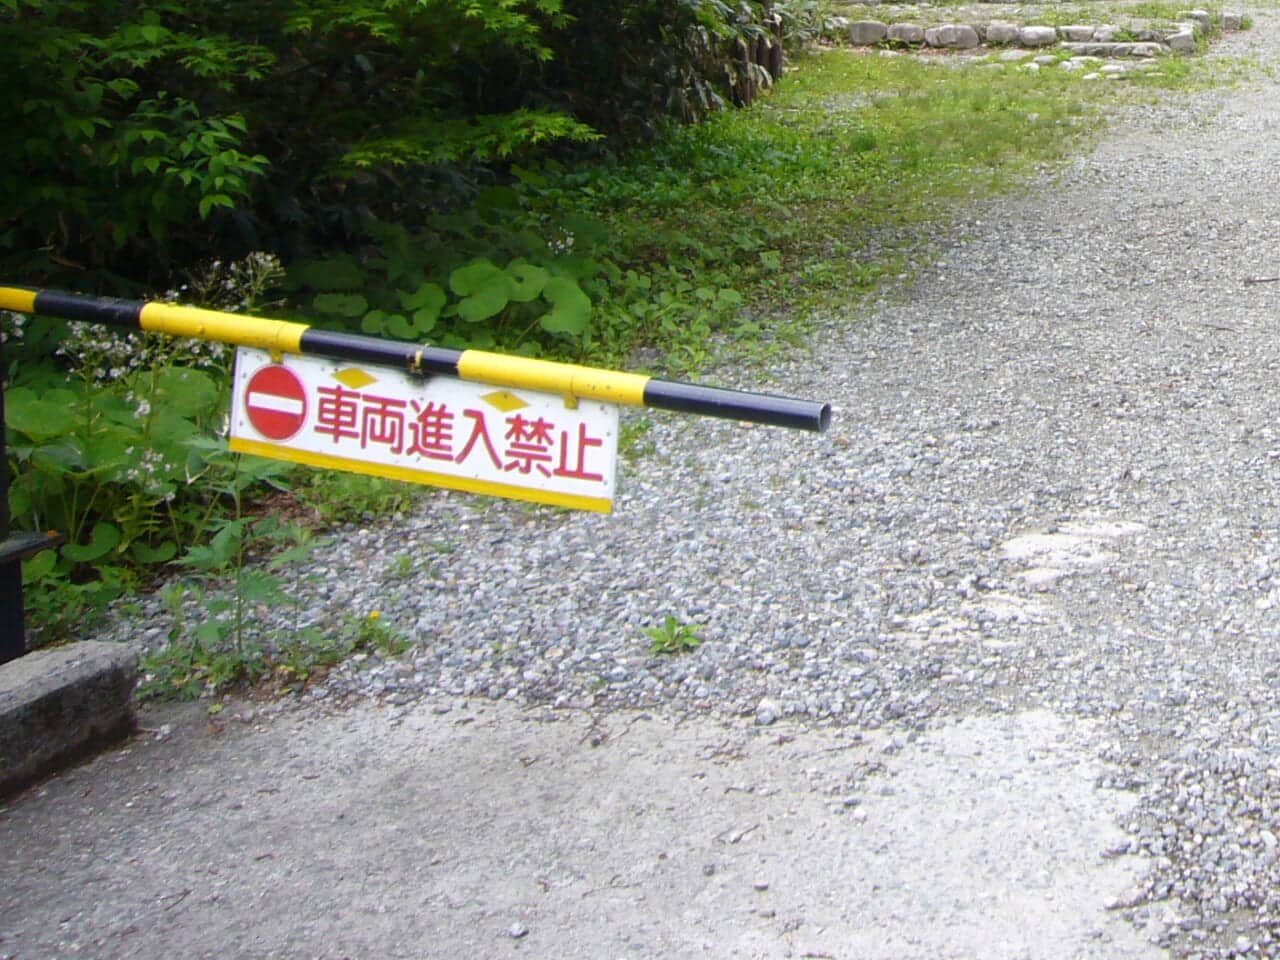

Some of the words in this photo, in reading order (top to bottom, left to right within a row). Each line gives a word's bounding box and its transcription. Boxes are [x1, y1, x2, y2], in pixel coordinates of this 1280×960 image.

[313, 386, 603, 482] 車両進入禁止
